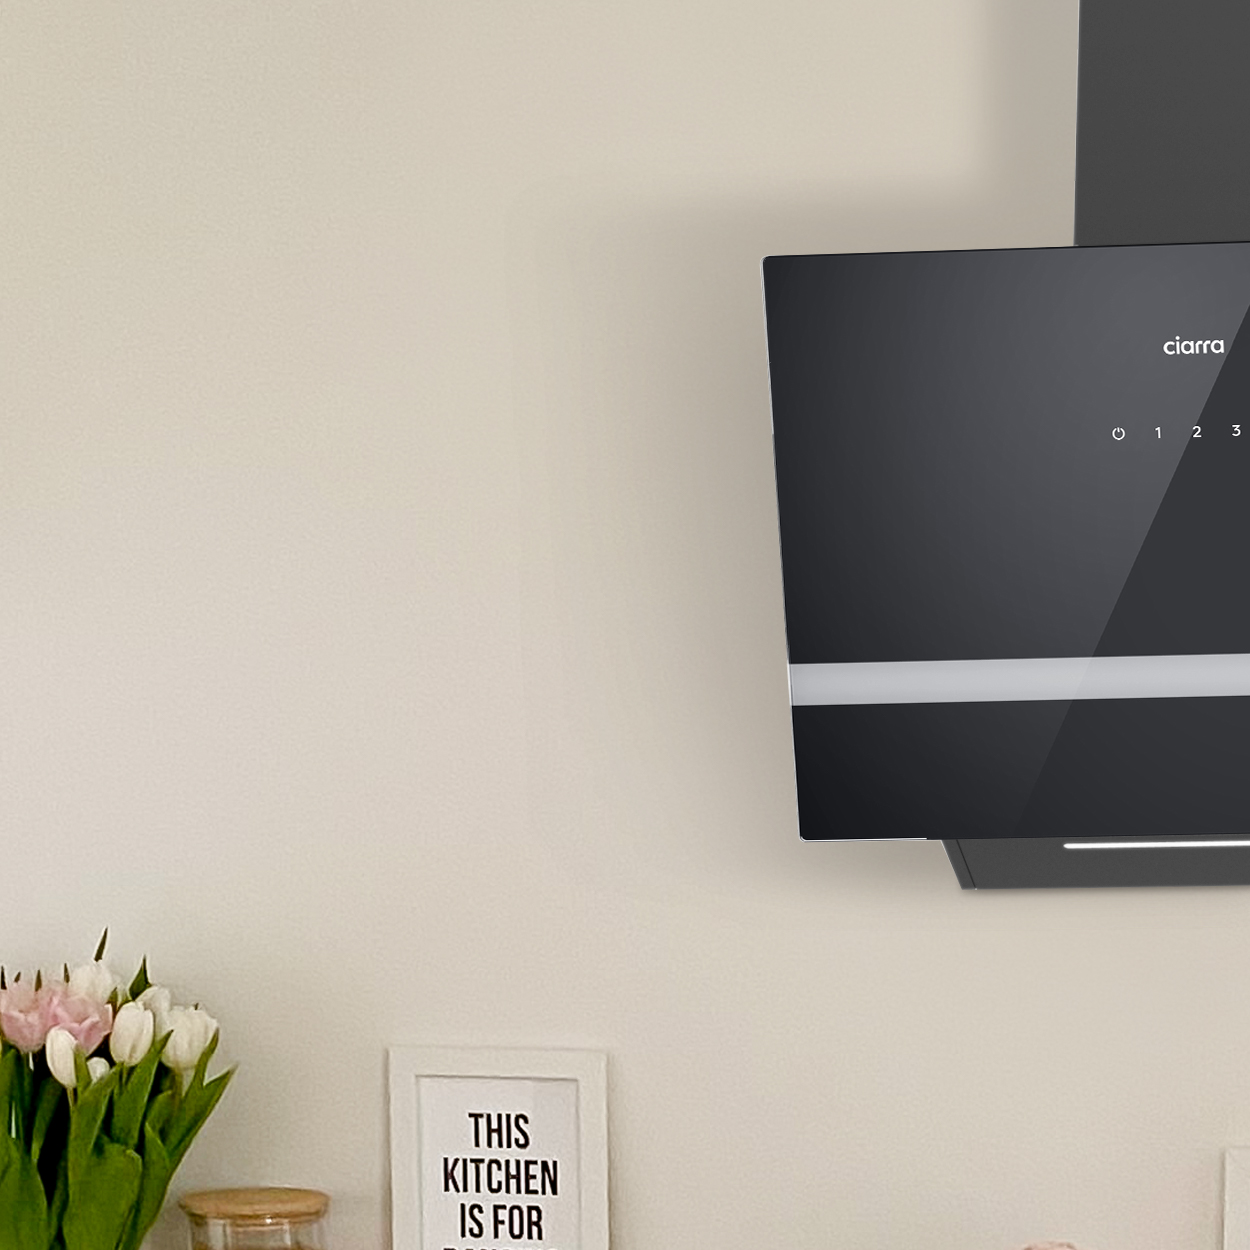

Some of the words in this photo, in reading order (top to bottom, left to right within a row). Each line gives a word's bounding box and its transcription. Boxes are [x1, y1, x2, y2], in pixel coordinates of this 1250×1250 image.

[1163, 335, 1225, 355] ciarra
[1154, 426, 1162, 439] 1
[1192, 425, 1203, 438] 2
[1231, 424, 1242, 437] 3
[468, 1112, 530, 1149] THIS
[443, 1157, 558, 1196] KITCHEN
[460, 1203, 484, 1239] IS
[493, 1204, 543, 1240] FOR
